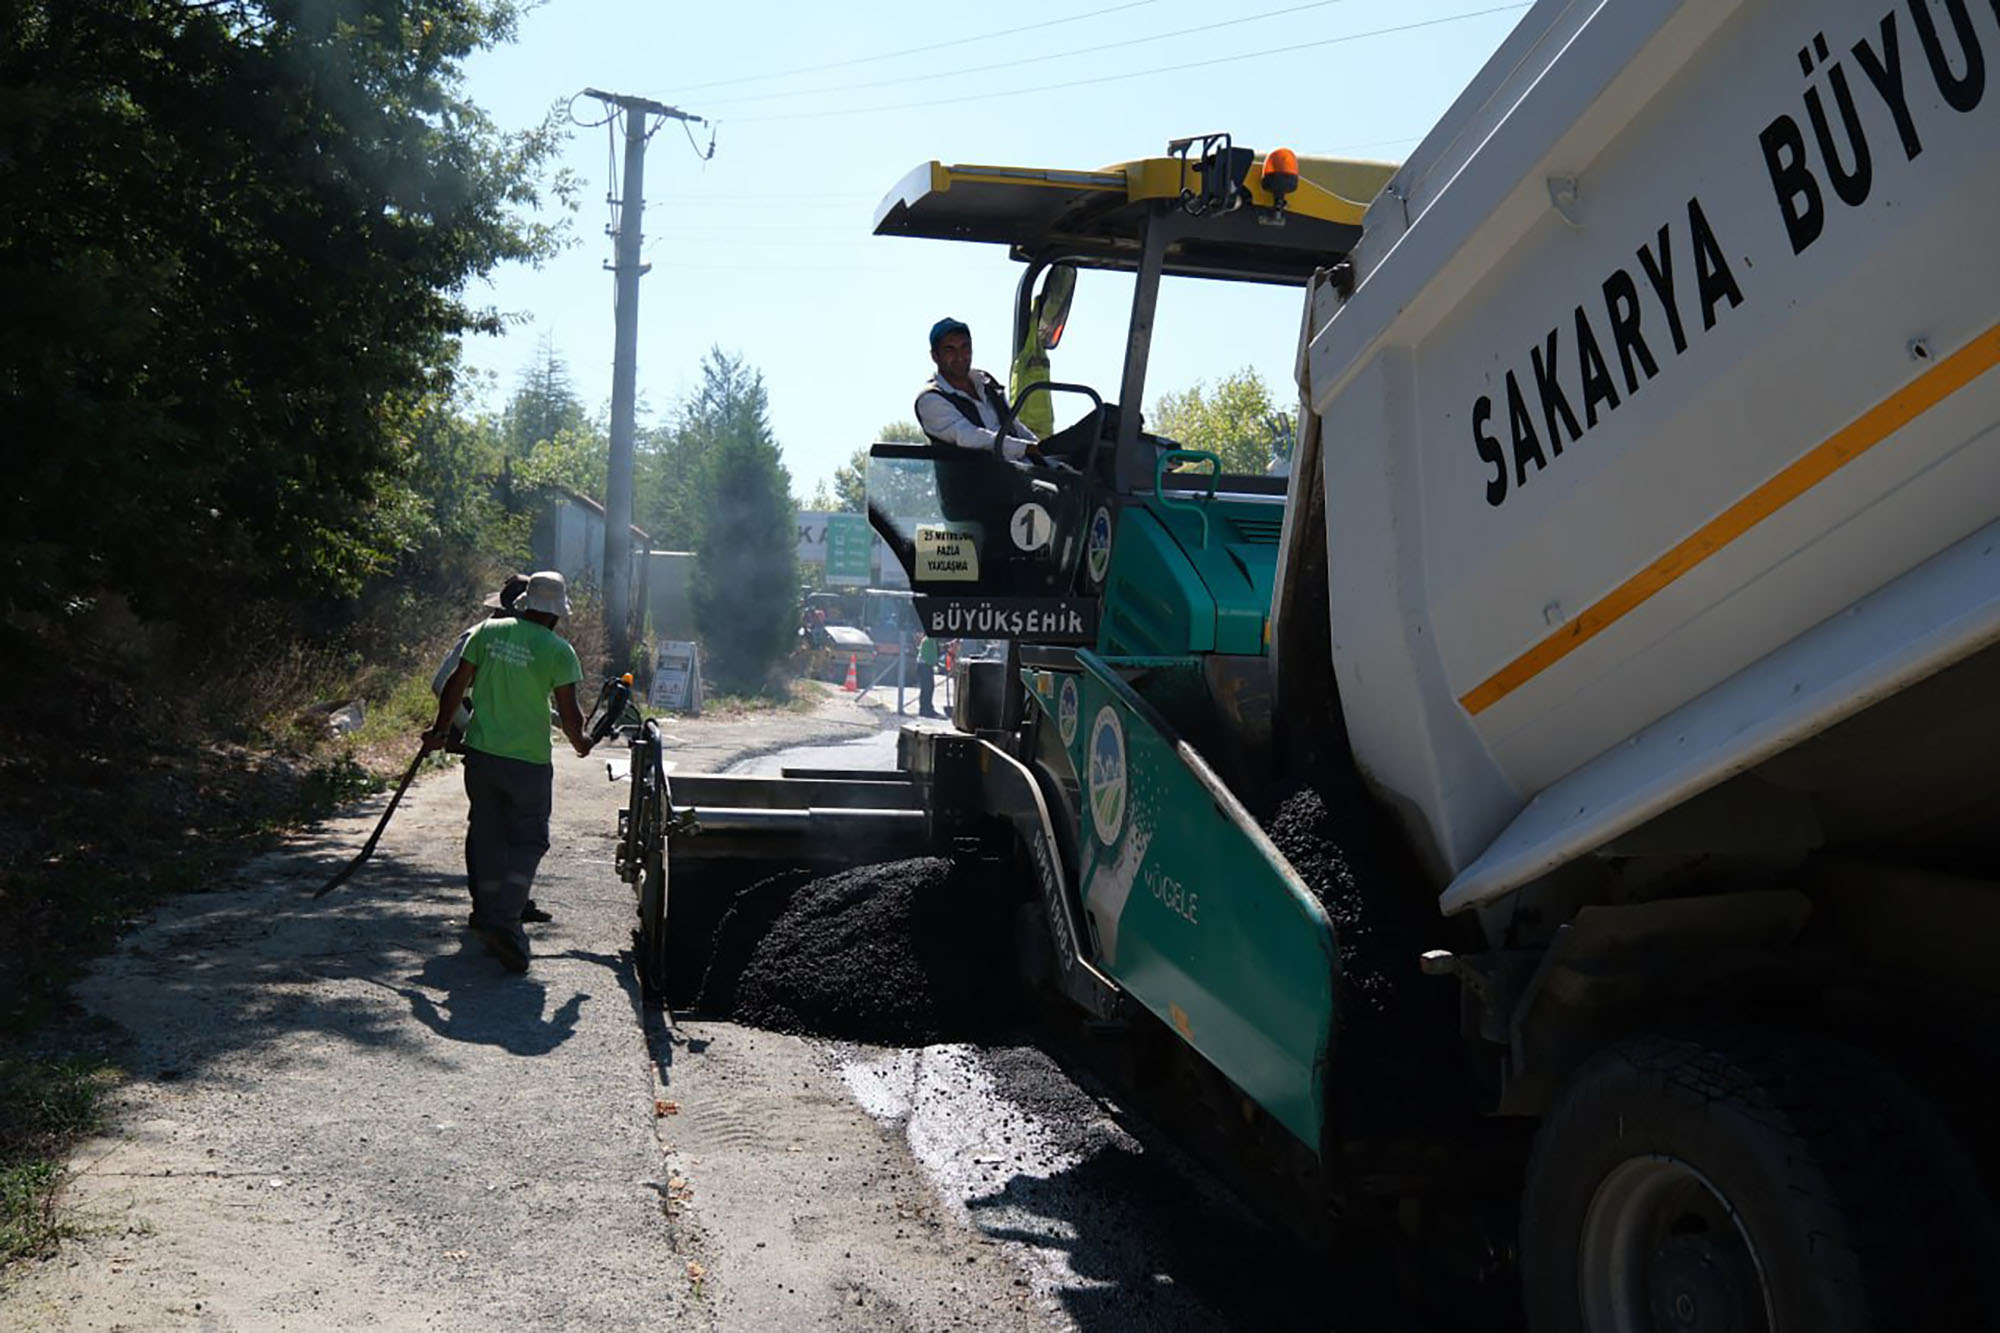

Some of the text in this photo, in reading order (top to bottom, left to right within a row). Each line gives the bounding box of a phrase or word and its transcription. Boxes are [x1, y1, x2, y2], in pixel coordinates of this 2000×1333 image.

[1472, 196, 1744, 507] SAKARYA
[1020, 509, 1034, 546] 1
[927, 560, 969, 573] YAKLAŞMA
[936, 545, 960, 556] FAZLA
[932, 603, 1083, 635] BÜYÜKŞEHİR
[1144, 863, 1198, 926] VÖGELE
